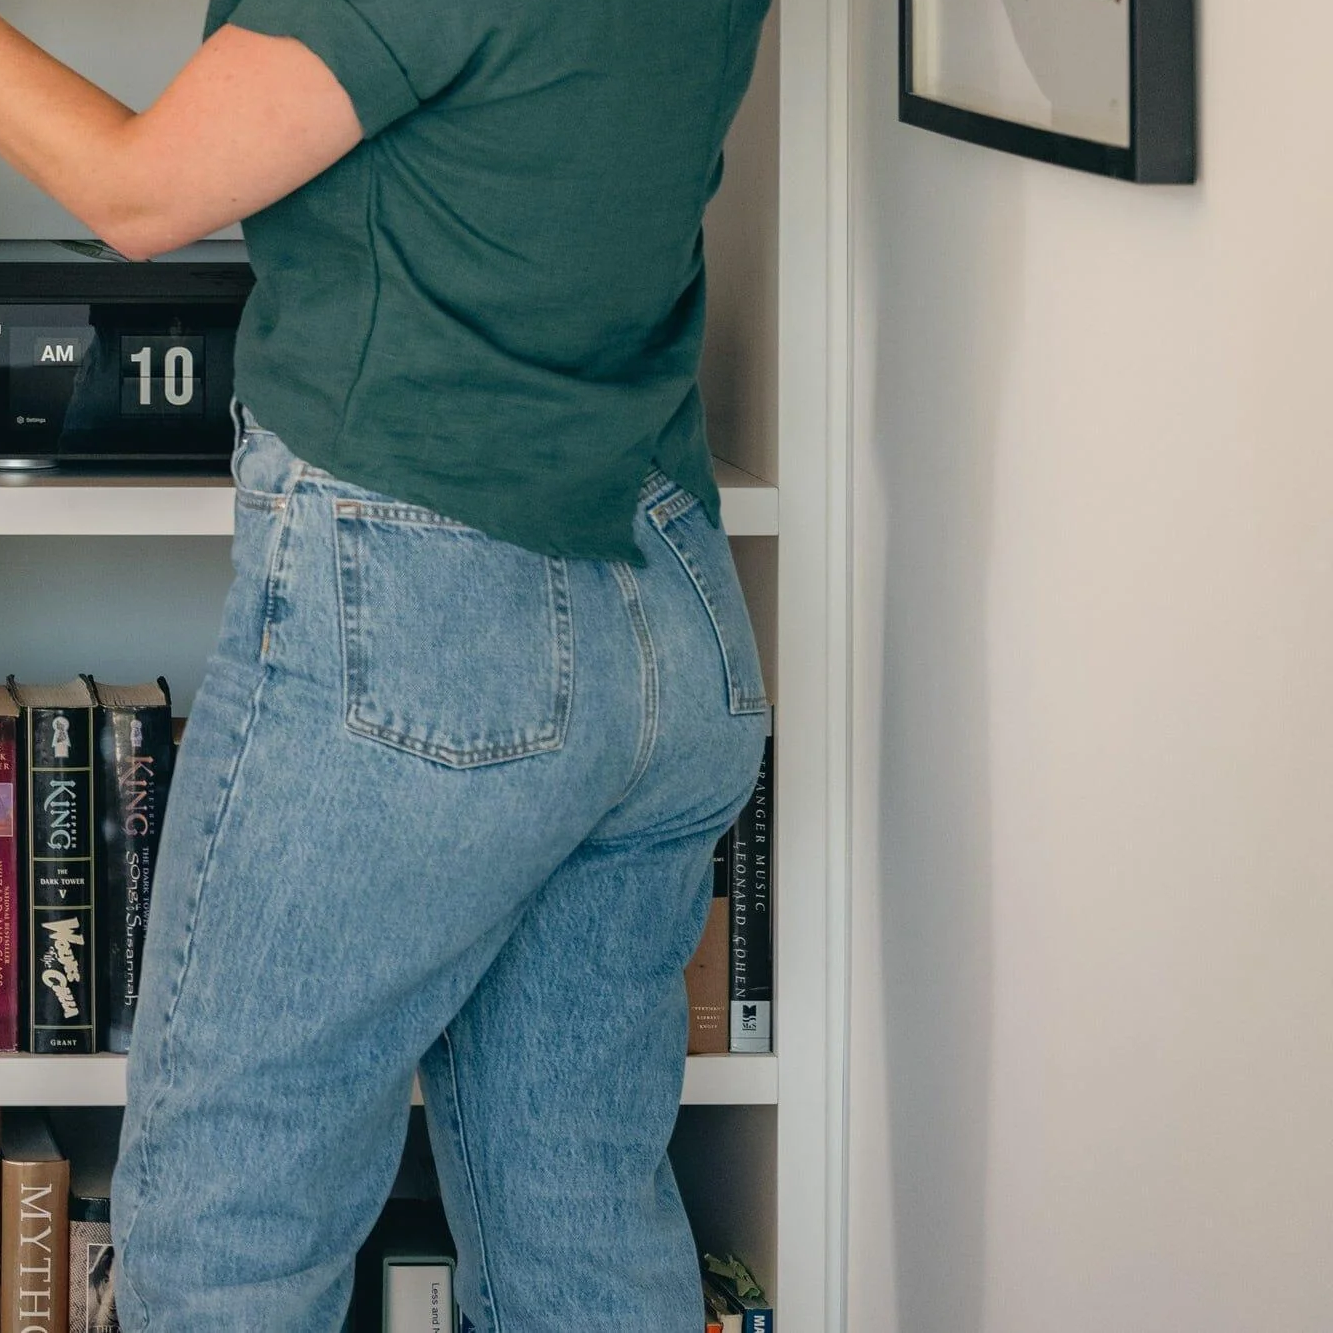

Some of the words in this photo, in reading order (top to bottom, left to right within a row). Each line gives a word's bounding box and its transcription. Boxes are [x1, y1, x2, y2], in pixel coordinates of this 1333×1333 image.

[41, 345, 74, 362] AM
[131, 346, 194, 406] 10
[43, 779, 76, 851] KING
[734, 840, 747, 925] LEONARD
[755, 854, 766, 912] MUSIC
[734, 935, 746, 998] COHEN
[19, 1183, 52, 1333] MYTH
